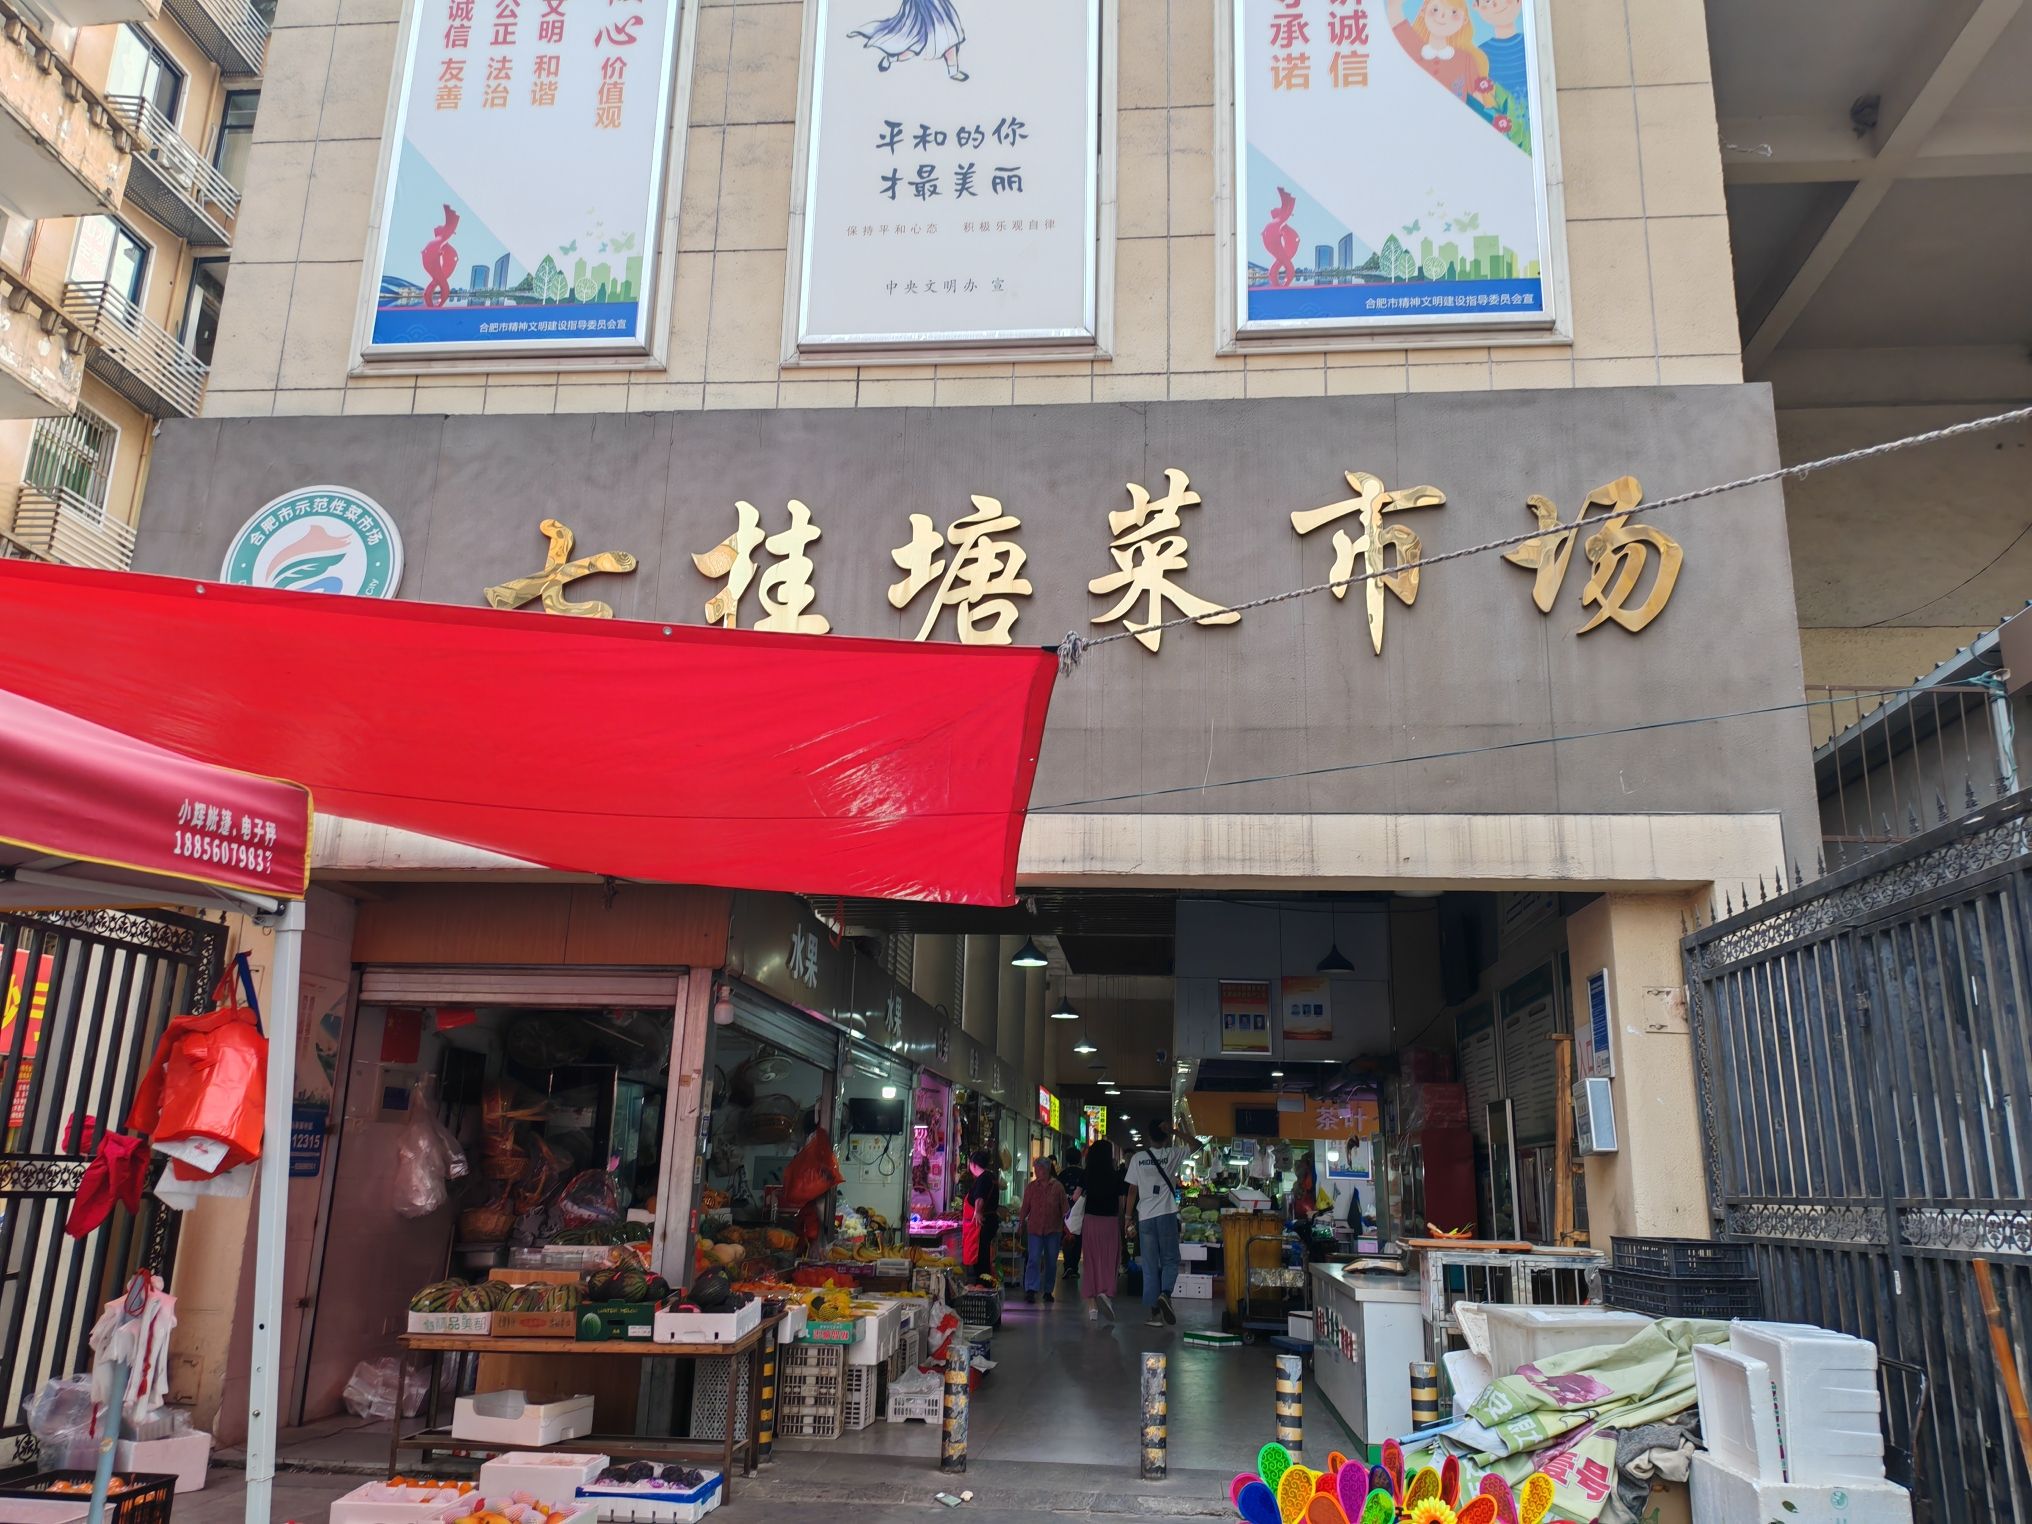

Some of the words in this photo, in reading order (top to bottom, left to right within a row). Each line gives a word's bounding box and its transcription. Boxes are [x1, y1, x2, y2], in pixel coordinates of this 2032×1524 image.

[444, 0, 475, 49] 诚信
[489, 0, 520, 46] 公正
[538, 0, 567, 43] 文明
[1328, 0, 1370, 88] 诚信
[1270, 0, 1311, 90] 承诺
[435, 58, 467, 110] 友善
[482, 56, 513, 109] 法治
[530, 55, 561, 107] 和谐
[876, 116, 1029, 155] 平和的你
[880, 162, 1023, 201] 才最美丽
[847, 223, 938, 237] 保持平和心态
[963, 219, 1056, 232] 积极乐观自律
[886, 278, 978, 295] 中央文明办
[991, 277, 1005, 292] 宣
[1365, 293, 1534, 310] 合肥市精神文明建设指导委员会宣
[479, 319, 627, 333] 合肥市精神文明建设指导委员会宣
[250, 498, 383, 546] 合肥市示范性菜市场
[787, 922, 819, 989] 水果
[293, 1133, 321, 1149] 12315
